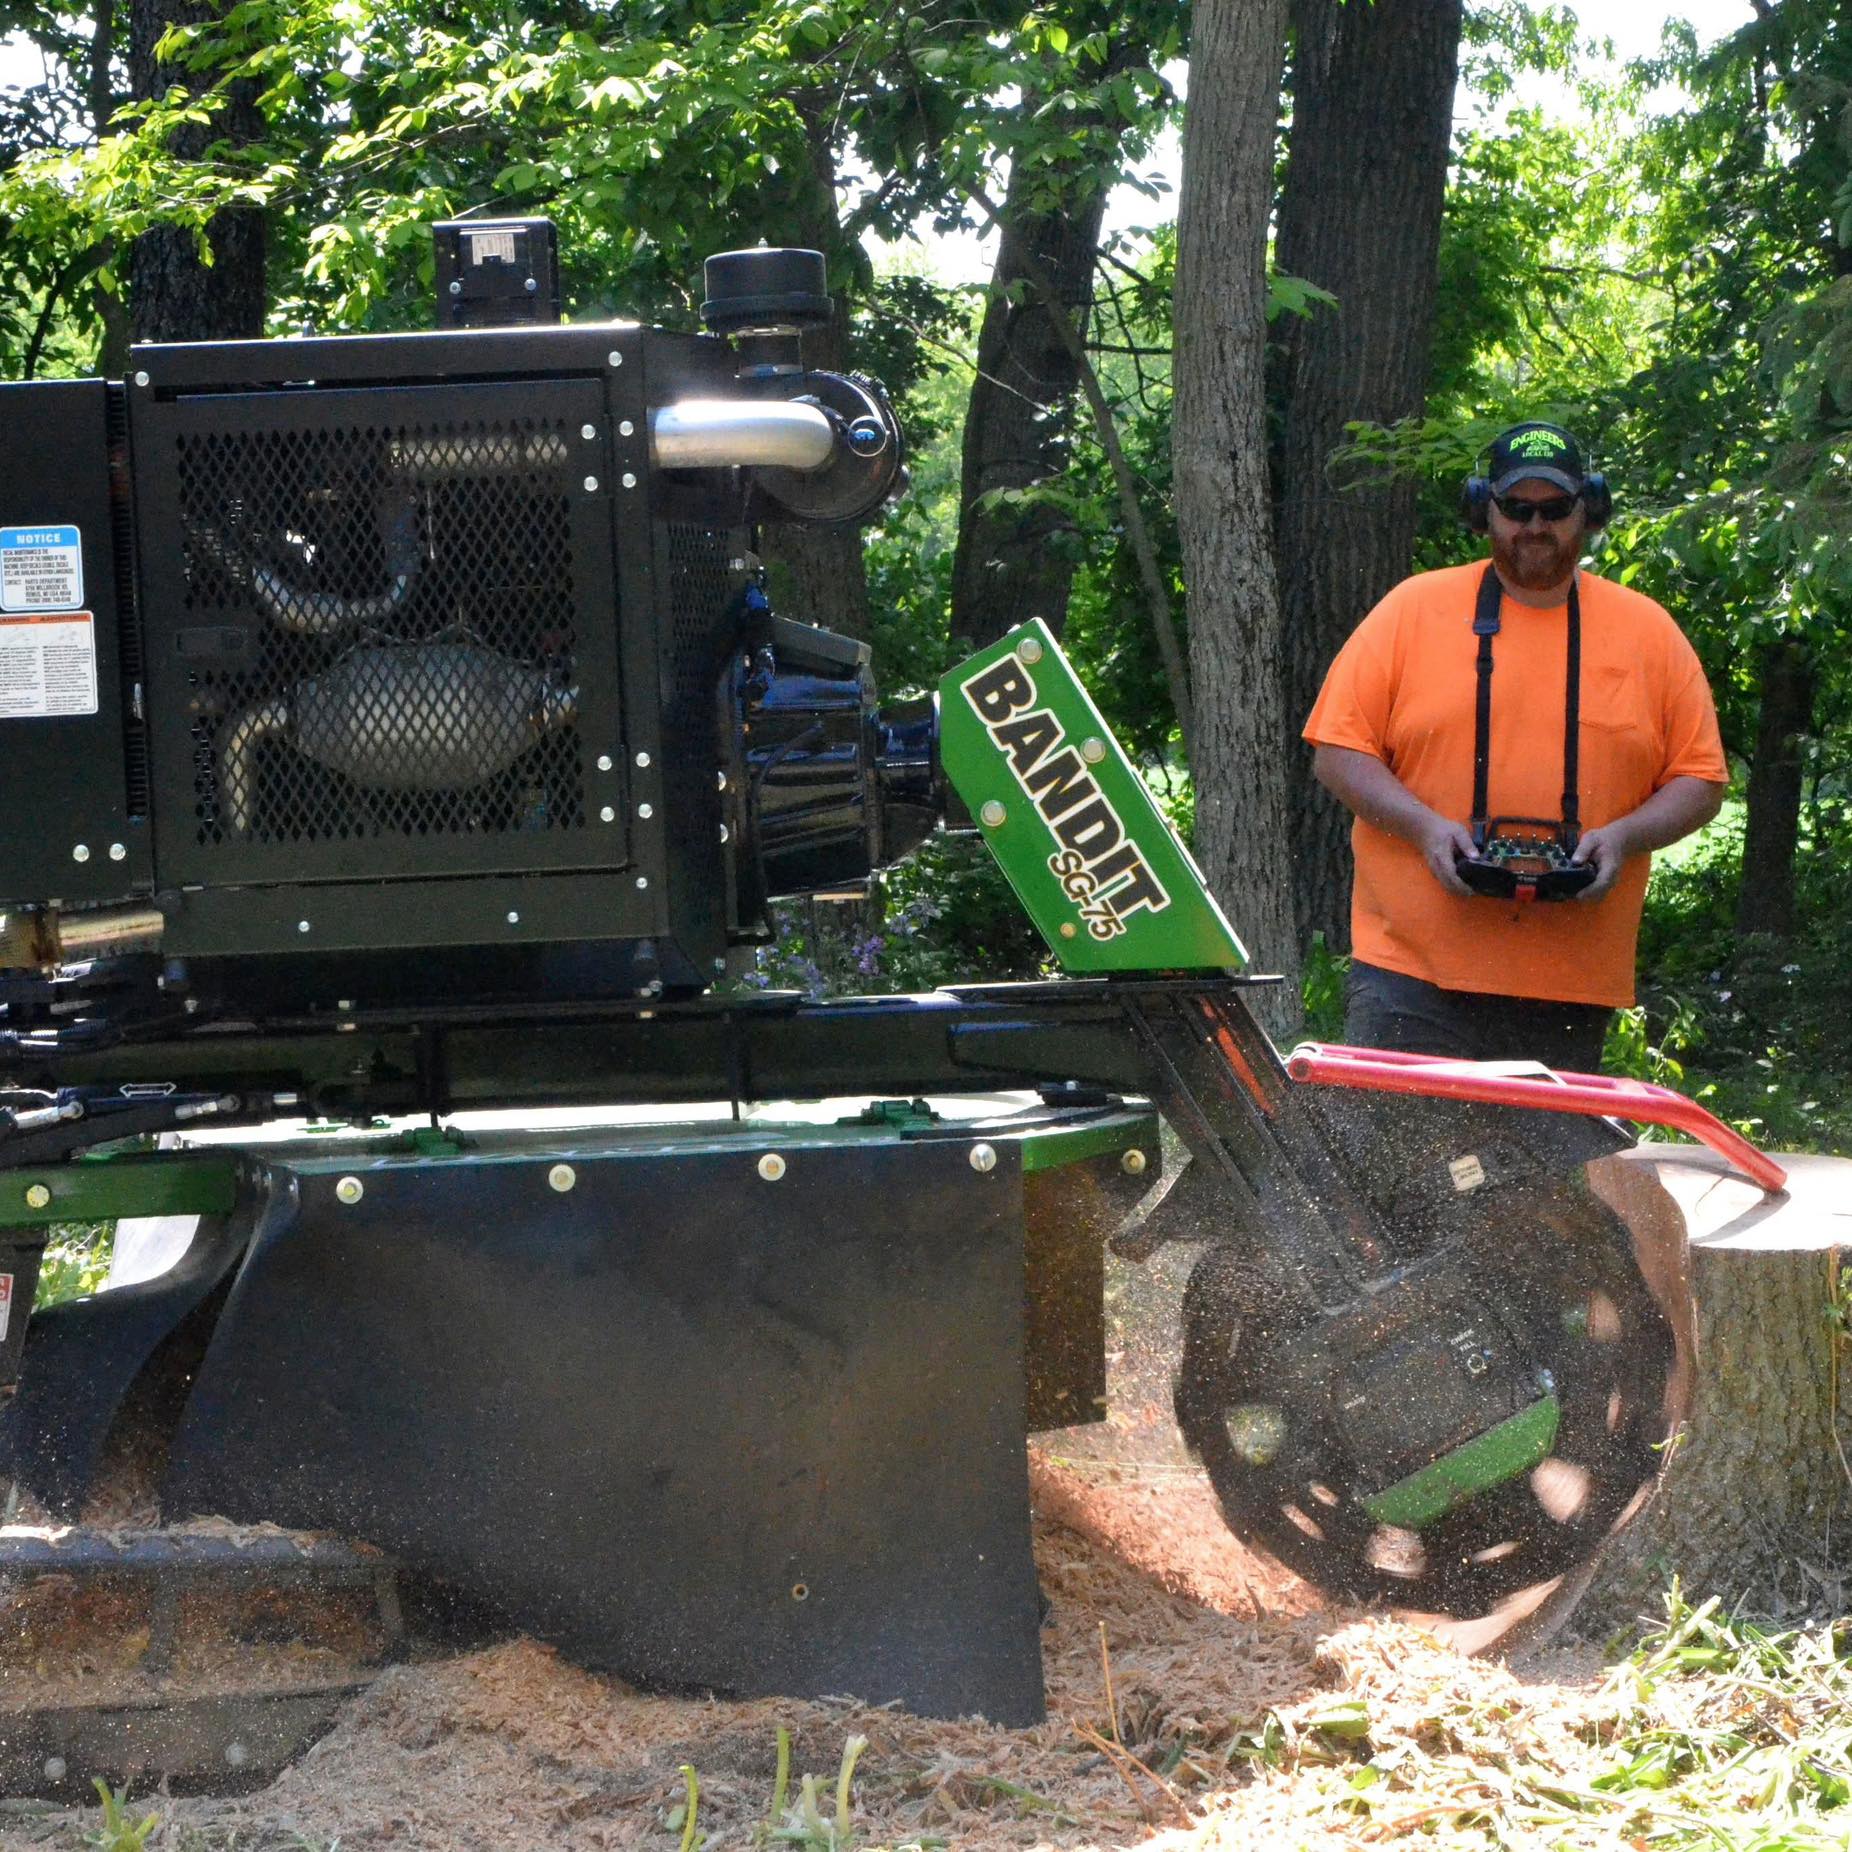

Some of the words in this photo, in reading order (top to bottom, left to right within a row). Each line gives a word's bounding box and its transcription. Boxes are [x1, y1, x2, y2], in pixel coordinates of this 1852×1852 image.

[1510, 430, 1567, 451] ENGINEERS
[16, 533, 62, 544] NOTICE
[960, 652, 1171, 920] BANDIT
[1047, 848, 1127, 941] SG-75
